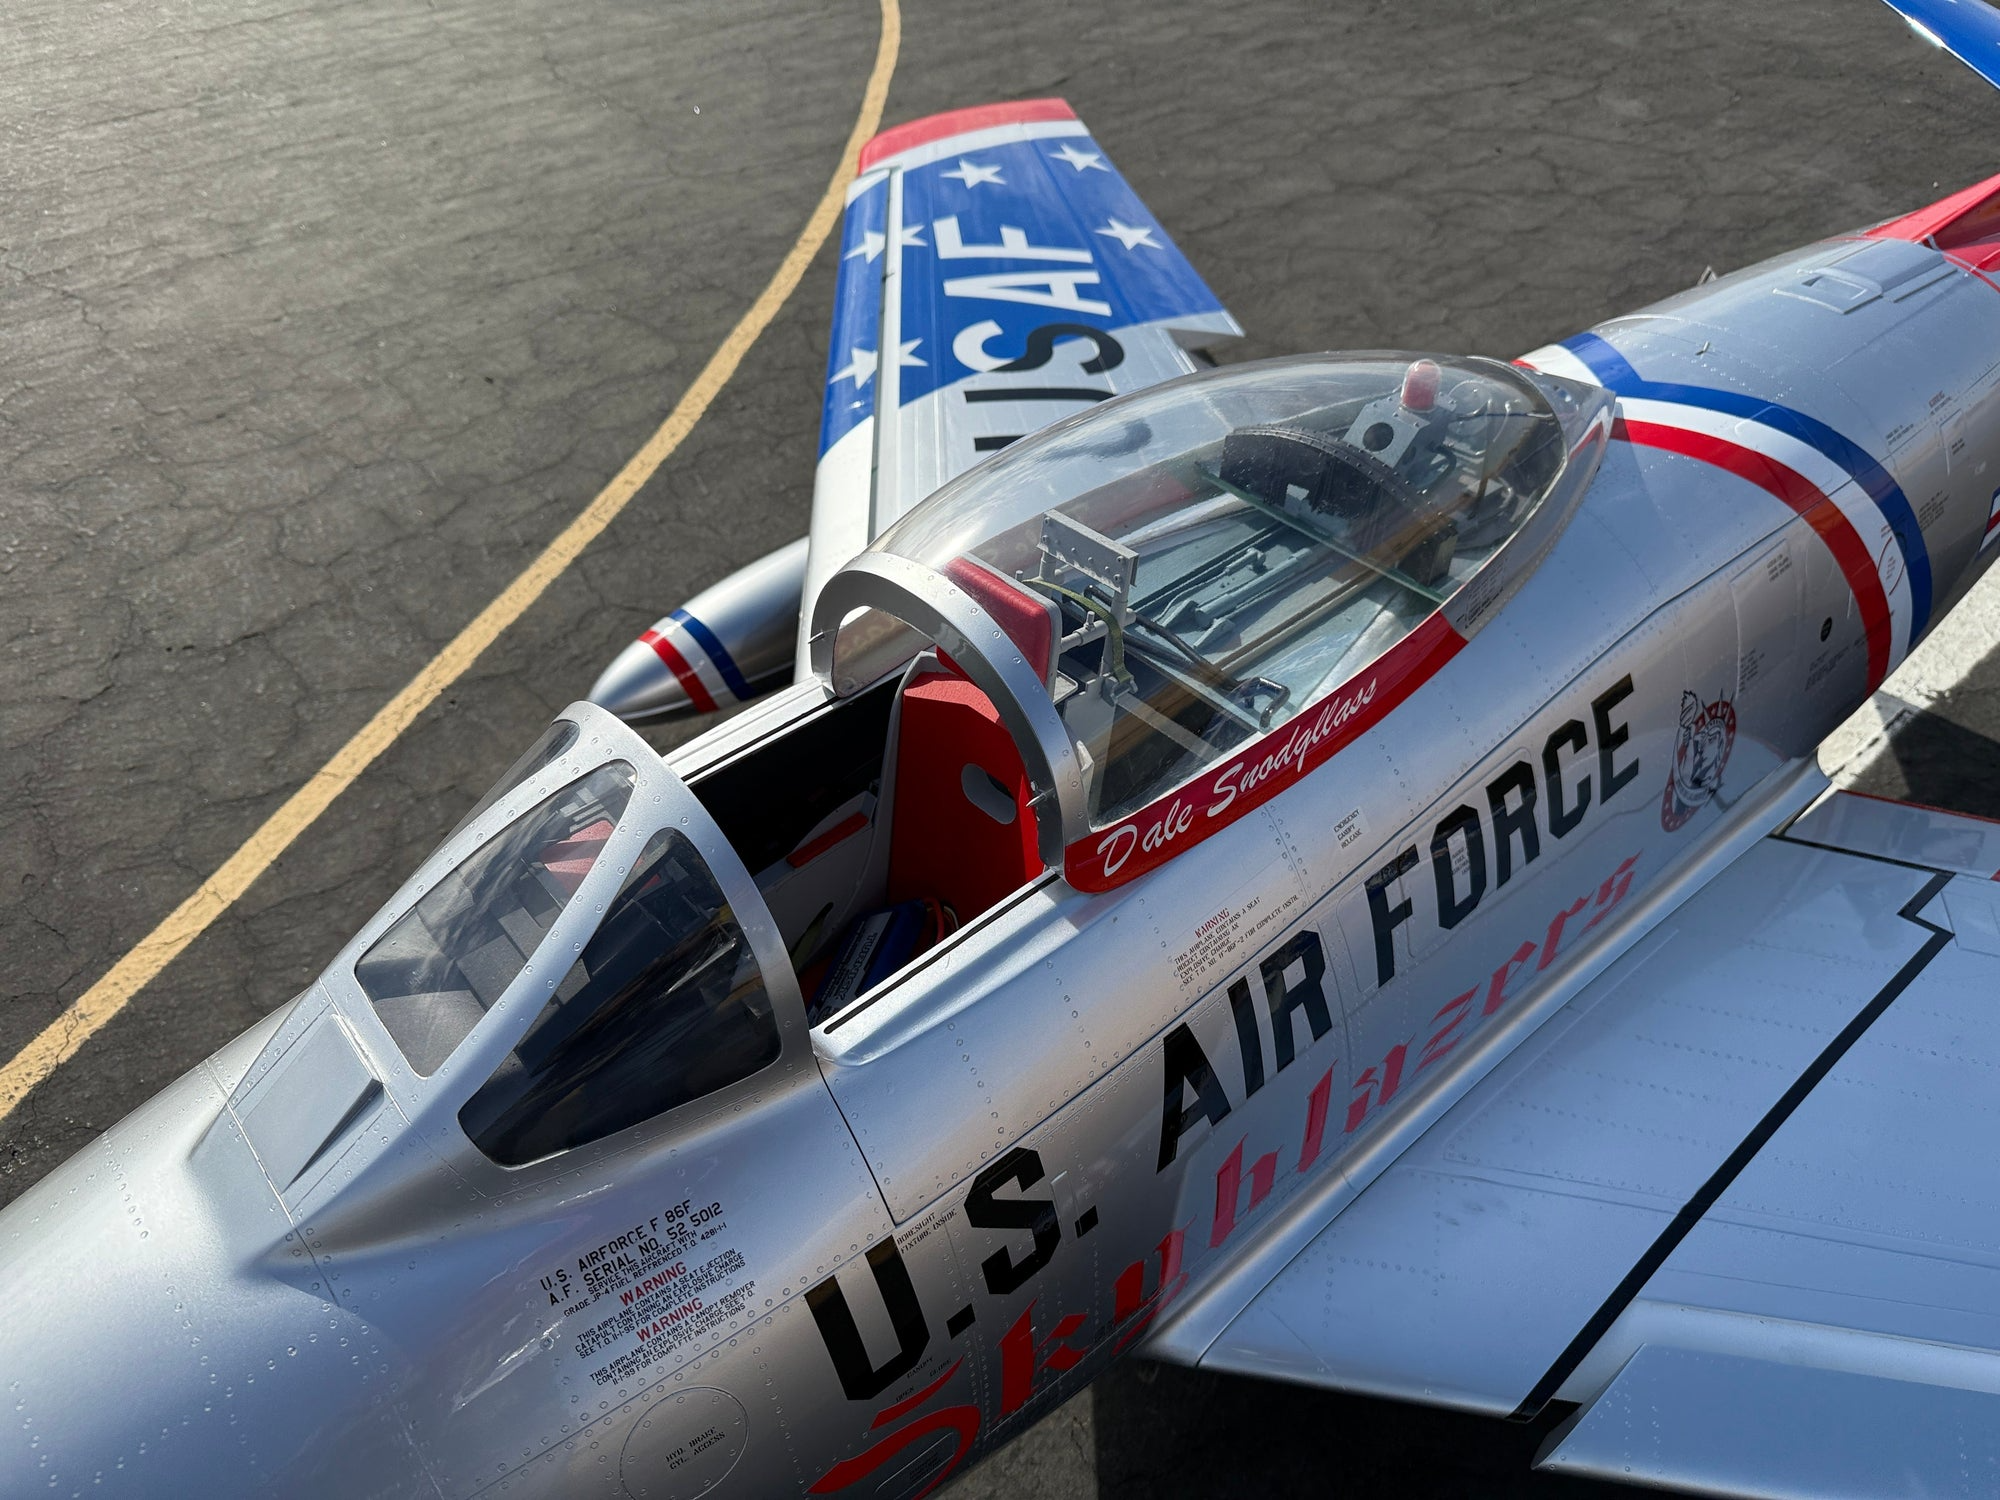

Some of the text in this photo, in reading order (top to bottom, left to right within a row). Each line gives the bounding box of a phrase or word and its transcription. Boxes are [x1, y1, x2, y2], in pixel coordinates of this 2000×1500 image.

[1097, 798, 1194, 877] Dale
[1156, 672, 1640, 1175] AIR FORCE
[1196, 908, 1229, 938] WARNING
[540, 1199, 690, 1291] U.S. AIRFORCE F 86F
[549, 1202, 723, 1306] A.F. SERIAL NO. 52 5012
[588, 1230, 697, 1295] SERVICE THIS AIRCRAFT WITH
[619, 1262, 686, 1306] WARNING
[803, 1146, 1099, 1401] U.S.
[564, 1298, 590, 1317] GRADE
[592, 1287, 610, 1302] JP-4
[610, 1277, 632, 1292] FUEL
[575, 1252, 744, 1354] CATAPULT CONTAINING AN EXPLOSIVE CHARGE
[577, 1248, 736, 1343] THIS AIRPLANE CONTAINS A SEAT EJECTION
[579, 1345, 596, 1359] SEE
[635, 1314, 652, 1327] FOR
[651, 1290, 694, 1318] COMPLETE
[693, 1259, 745, 1294] INSTRUCTIONS
[590, 1367, 610, 1380] THIS
[609, 1344, 647, 1372] AIRPLANE
[646, 1323, 684, 1348] CONTAINS
[690, 1302, 721, 1323] CANOPY
[719, 1281, 755, 1306] REMOVER
[635, 1358, 652, 1371] FOR
[693, 1302, 745, 1337] INSTRUCTIONS
[636, 1297, 702, 1342] WARNING
[597, 1356, 643, 1385] CONTAINING
[642, 1349, 654, 1359] AN
[653, 1324, 696, 1353] EXPLOSIVE
[695, 1307, 726, 1328] CHARGE
[724, 1297, 742, 1312] SEE
